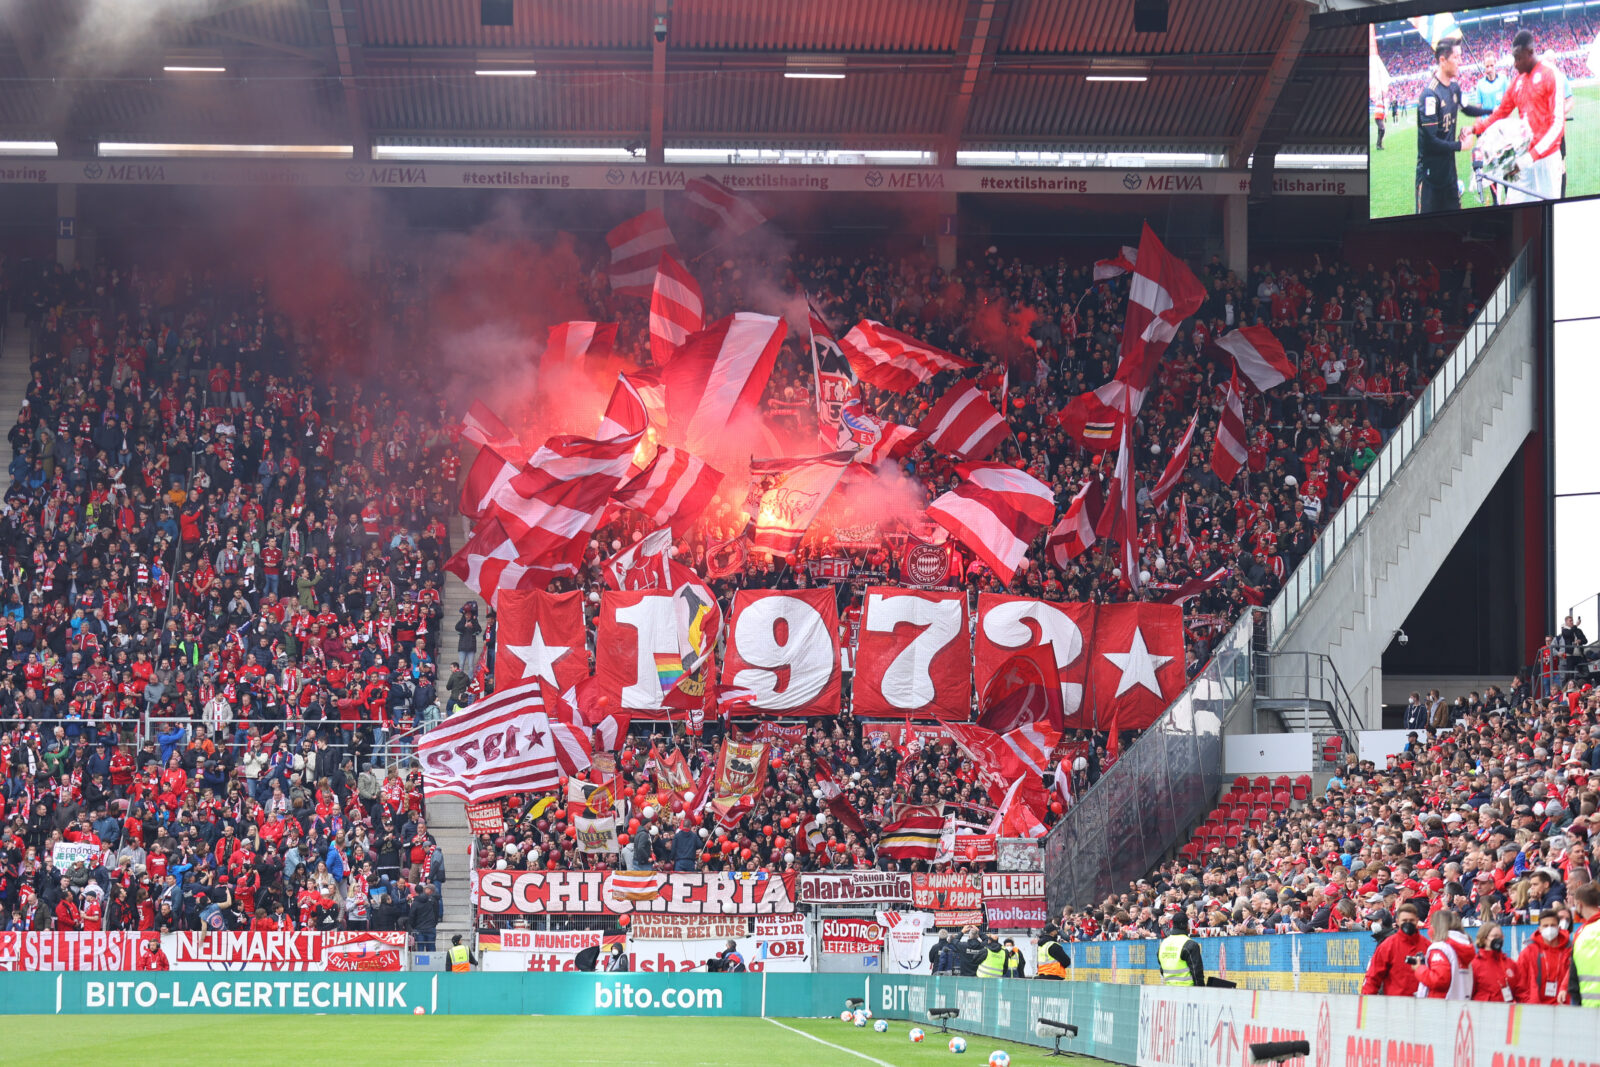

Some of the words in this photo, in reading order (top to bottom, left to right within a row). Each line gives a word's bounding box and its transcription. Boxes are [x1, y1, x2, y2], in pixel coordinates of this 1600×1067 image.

[107, 165, 165, 180] MEWA
[369, 167, 427, 183] MEWA
[462, 171, 570, 187] #textilsharing
[630, 170, 686, 186] MEWA
[887, 173, 945, 188] MEWA
[722, 173, 829, 190] #textilsharing
[980, 176, 1087, 193] #textilsharing
[1146, 175, 1203, 191] MEWA
[60, 220, 73, 236] H
[767, 722, 801, 735] Bayern
[983, 875, 1045, 896] COLEGIO
[915, 889, 934, 906] RED
[950, 891, 982, 909] PRIDE
[756, 915, 777, 924] WIR
[779, 914, 804, 923] SIND
[632, 926, 682, 939] IMMER
[686, 926, 711, 939] BEI
[715, 925, 745, 938] UNS
[756, 926, 778, 936] BEI
[781, 924, 804, 935] DIR
[824, 920, 885, 941] SÜDTIROL
[177, 931, 321, 961] NEUMARKT
[504, 933, 531, 947] RED
[823, 940, 856, 953] LETZTE
[86, 981, 407, 1008] BITO-LAGERTECHNIK
[595, 982, 722, 1009] bito.com
